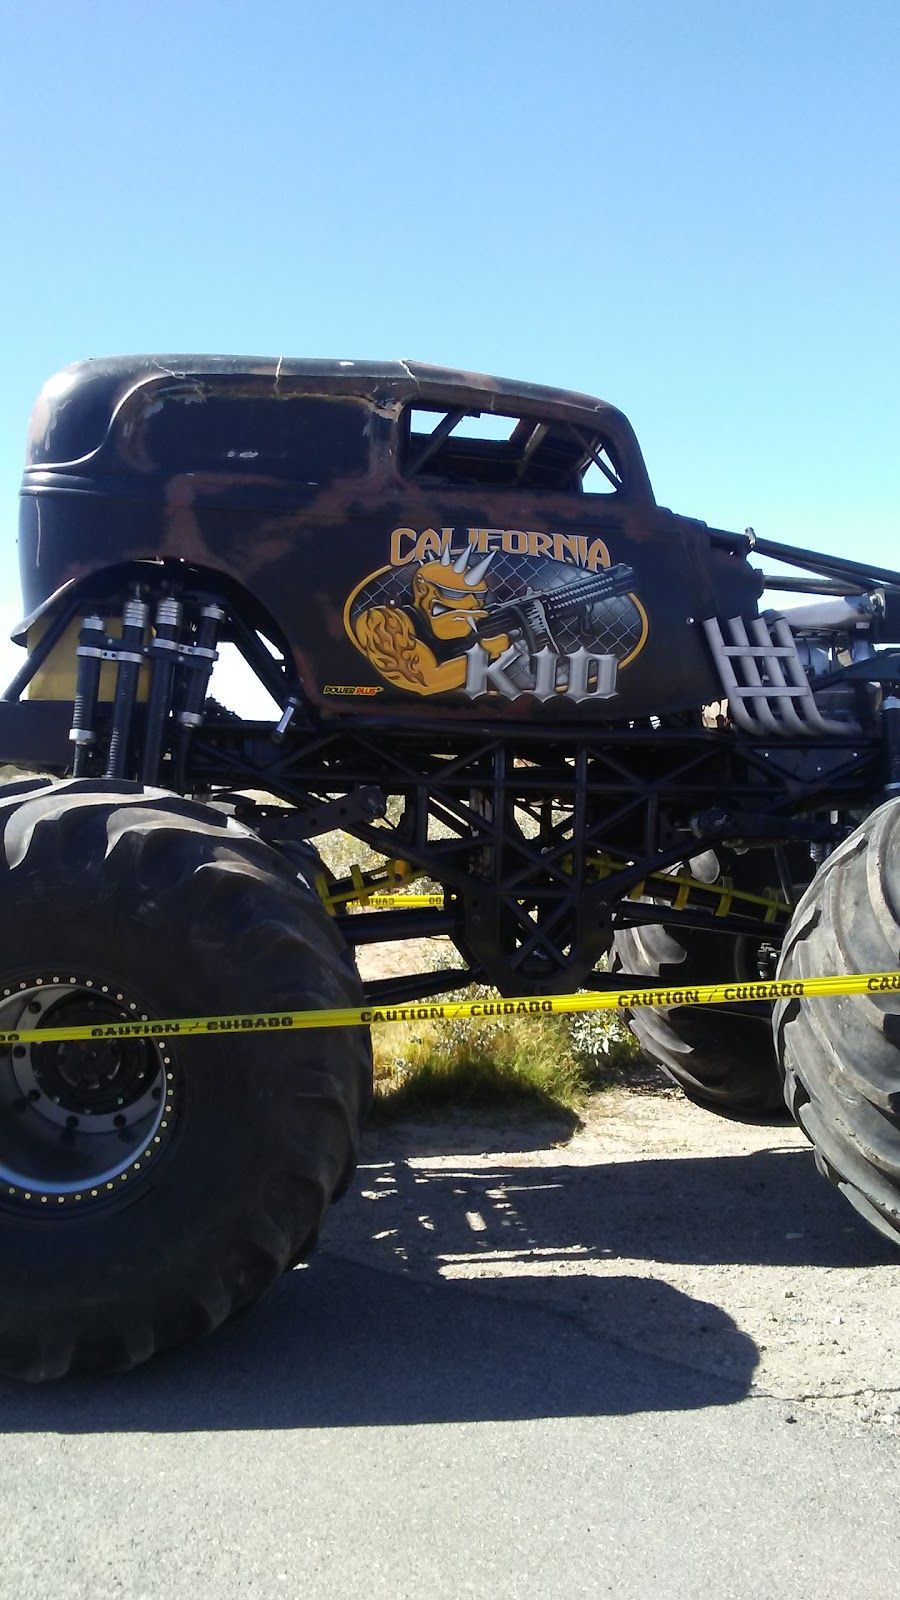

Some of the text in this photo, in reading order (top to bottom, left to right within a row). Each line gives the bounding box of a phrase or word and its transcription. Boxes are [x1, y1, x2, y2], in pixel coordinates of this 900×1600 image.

[390, 527, 612, 573] CALIFORNIA
[324, 686, 356, 694] POWER
[463, 642, 620, 704] KID
[91, 1023, 180, 1037] CAUTION
[207, 1016, 293, 1031] CUIDADO
[360, 1007, 445, 1022] CAUTION
[470, 1000, 553, 1016] CUIDADO
[617, 990, 699, 1007] CAUTION
[723, 983, 805, 1001] CUIDADO
